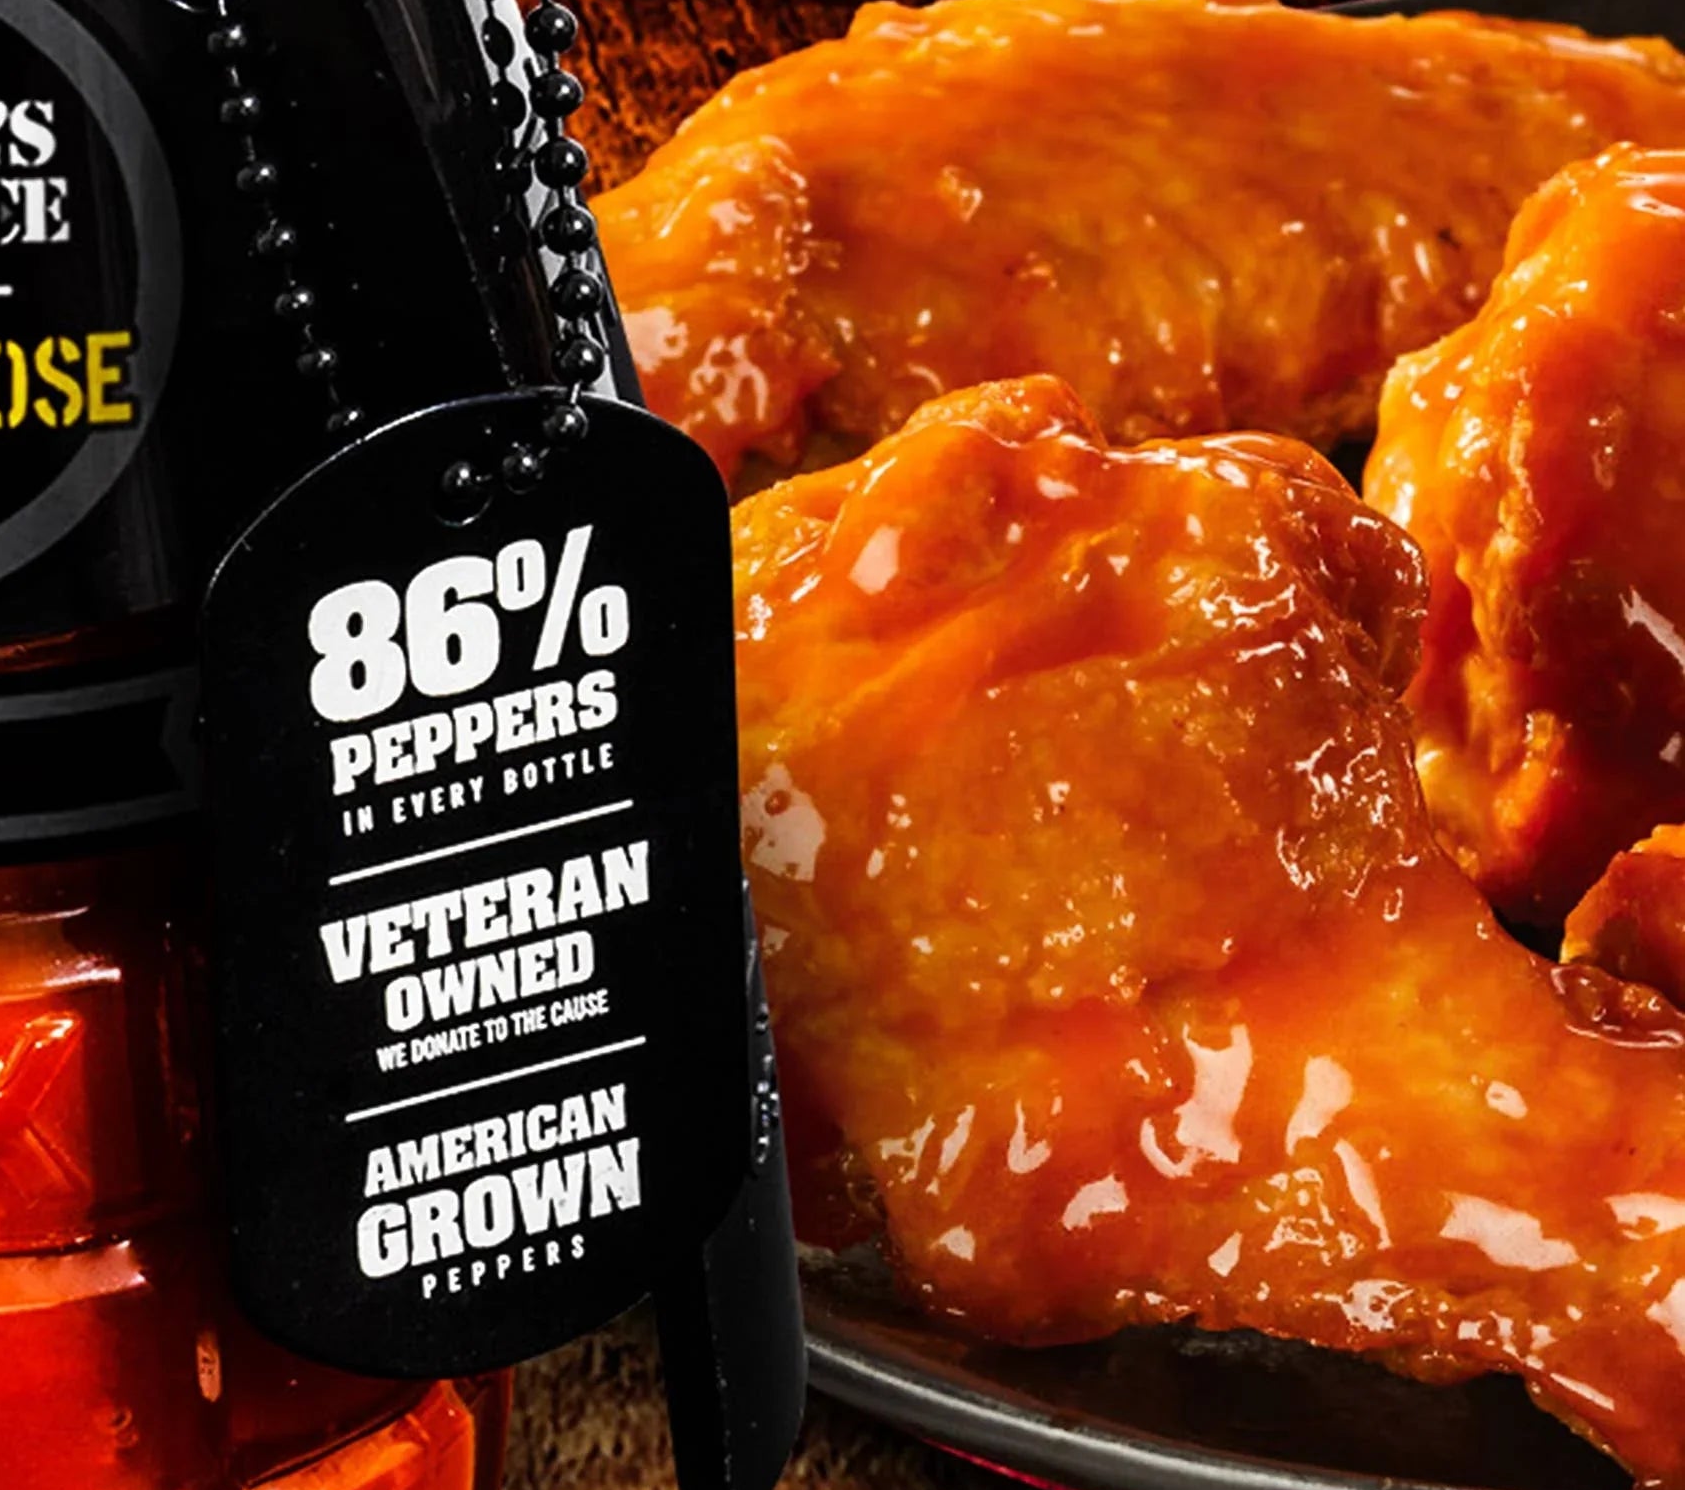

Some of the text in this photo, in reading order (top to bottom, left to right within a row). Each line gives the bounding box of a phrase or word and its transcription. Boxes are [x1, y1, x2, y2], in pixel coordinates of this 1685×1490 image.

[308, 524, 629, 722] 86%
[330, 670, 617, 796] PEPPERS
[343, 743, 613, 836] IN EVERY BOTTLE
[320, 840, 650, 984] VETERAN
[376, 989, 609, 1072] WE DONATE TO THE CAUSE
[385, 931, 594, 1033] OWNED
[364, 1083, 627, 1197] AMERICAN
[357, 1138, 641, 1279] GROWN
[423, 1234, 584, 1299] PEPPERS
